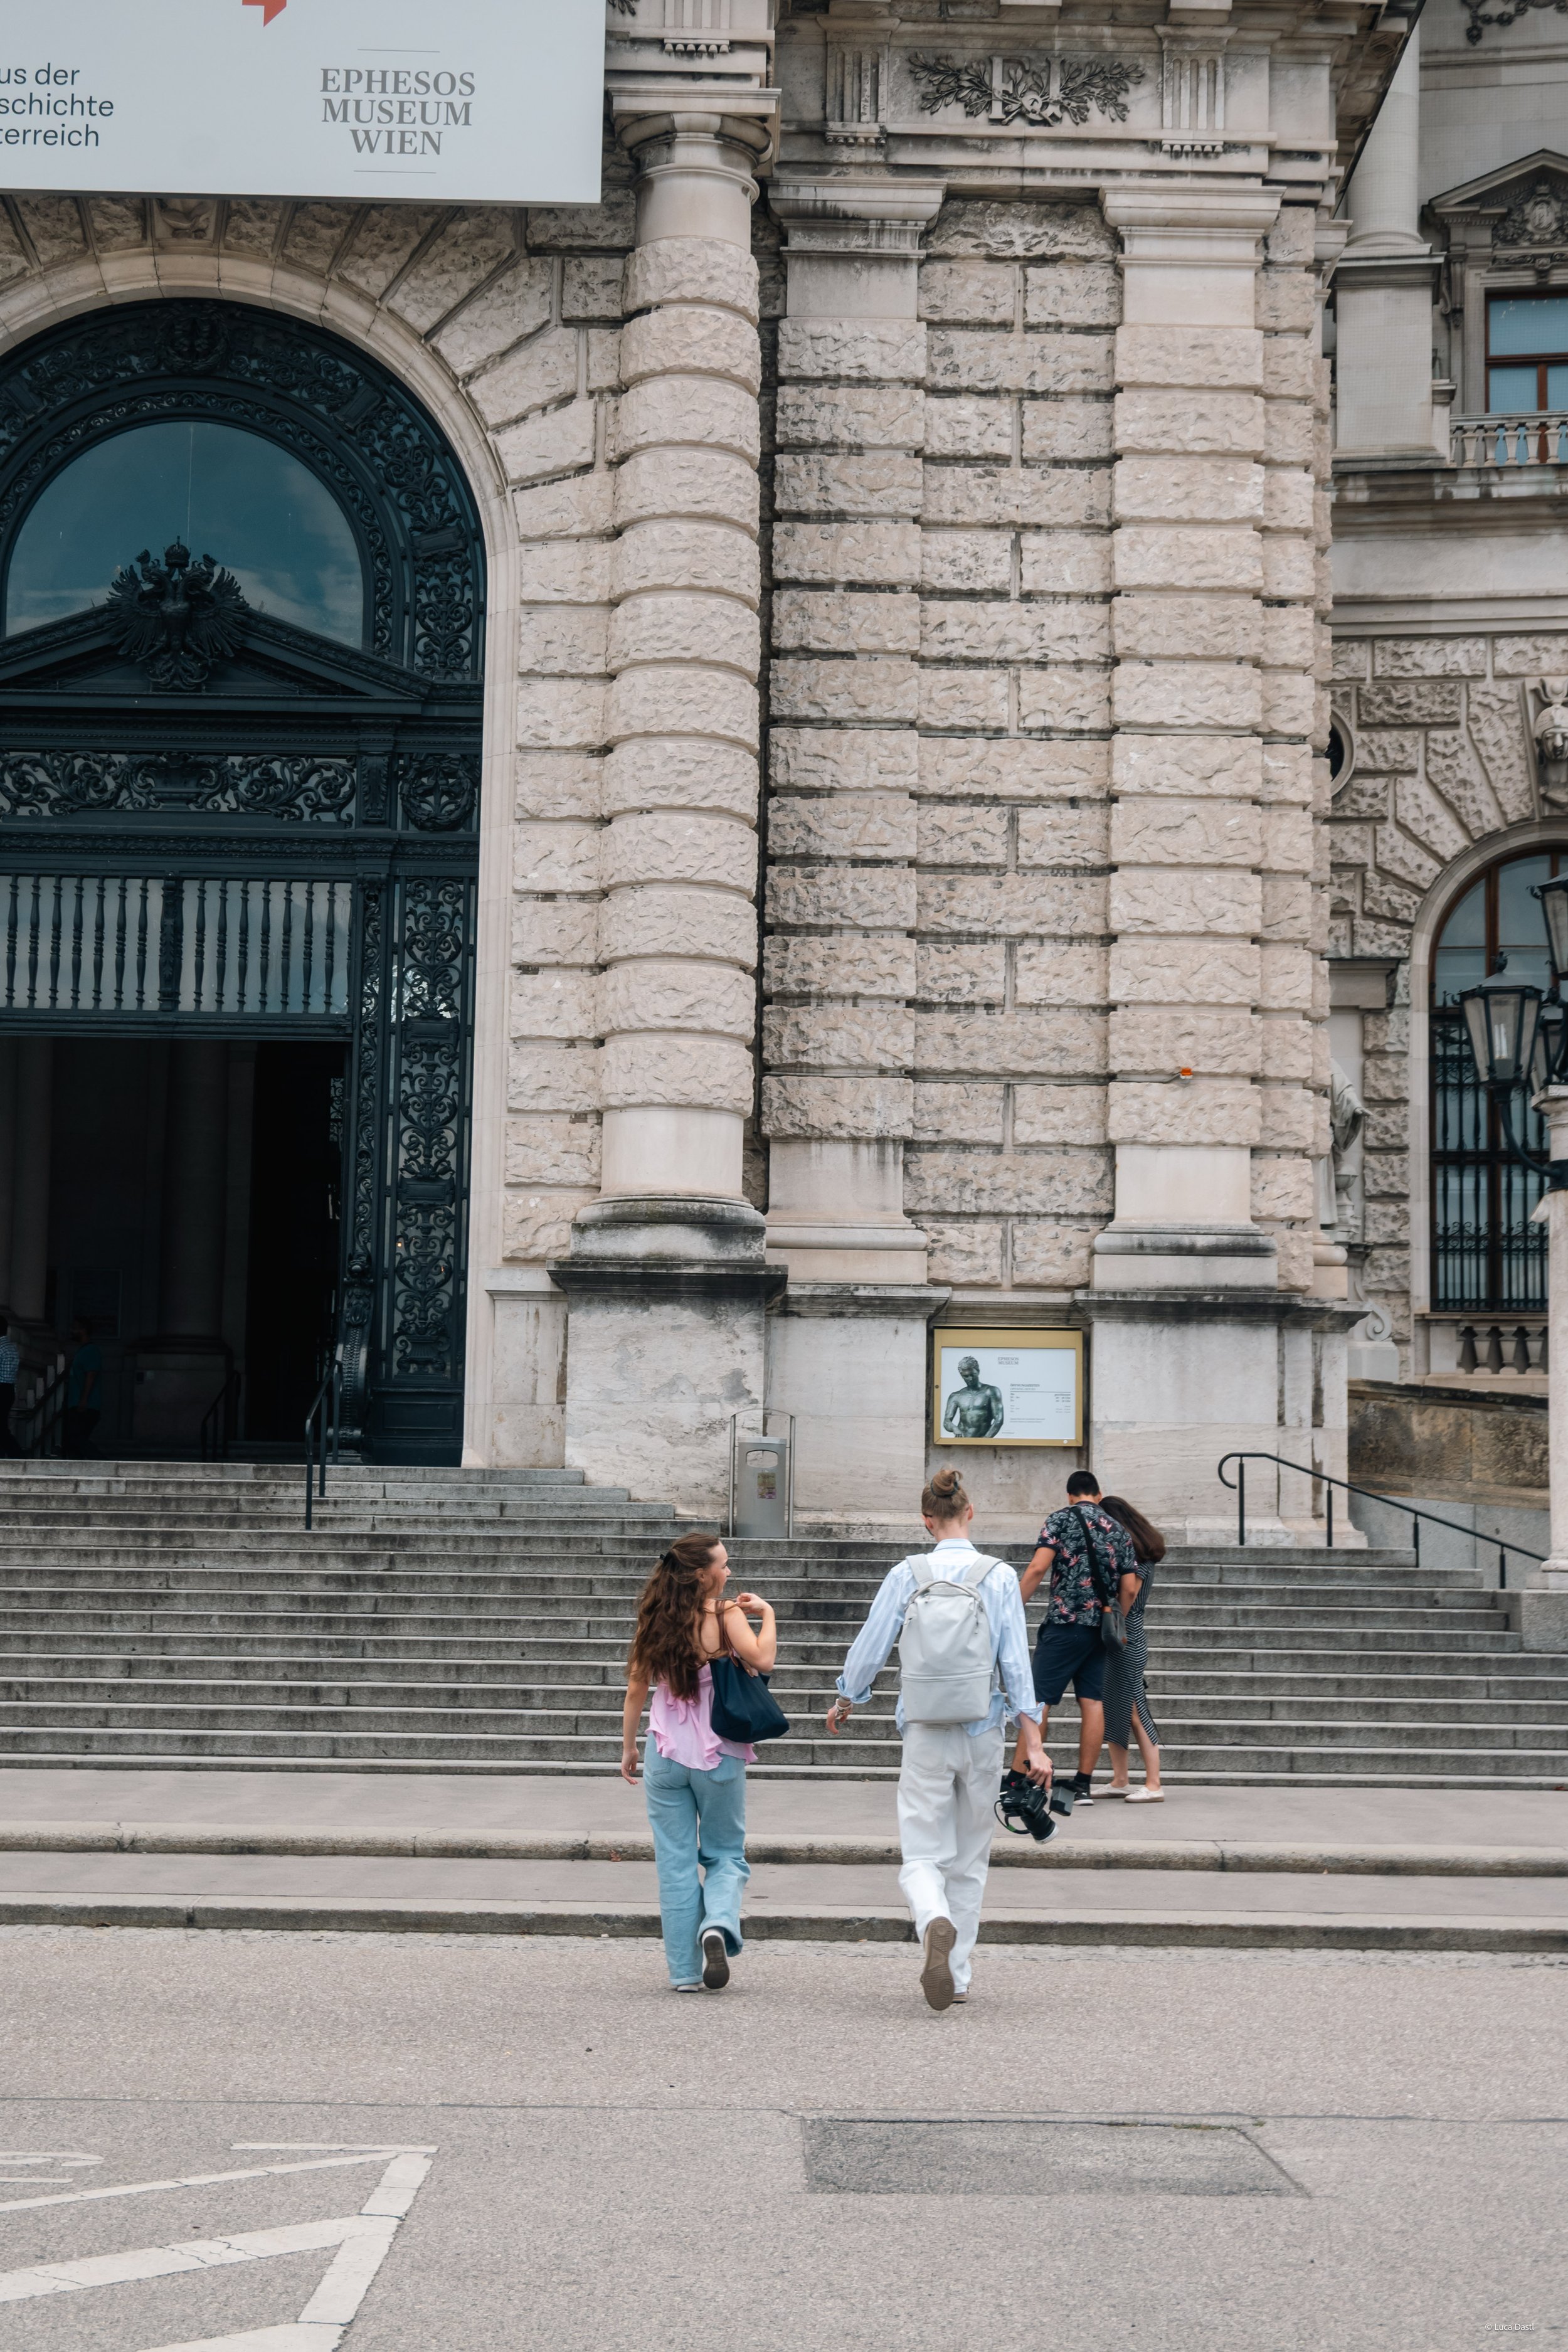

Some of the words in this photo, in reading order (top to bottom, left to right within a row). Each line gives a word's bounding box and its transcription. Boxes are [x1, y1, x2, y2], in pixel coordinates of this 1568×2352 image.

[35, 63, 80, 85] der
[320, 68, 475, 96] EPHESOS
[0, 92, 114, 117] schichte
[322, 98, 472, 126] MUSEUM
[349, 129, 443, 155] WIEN
